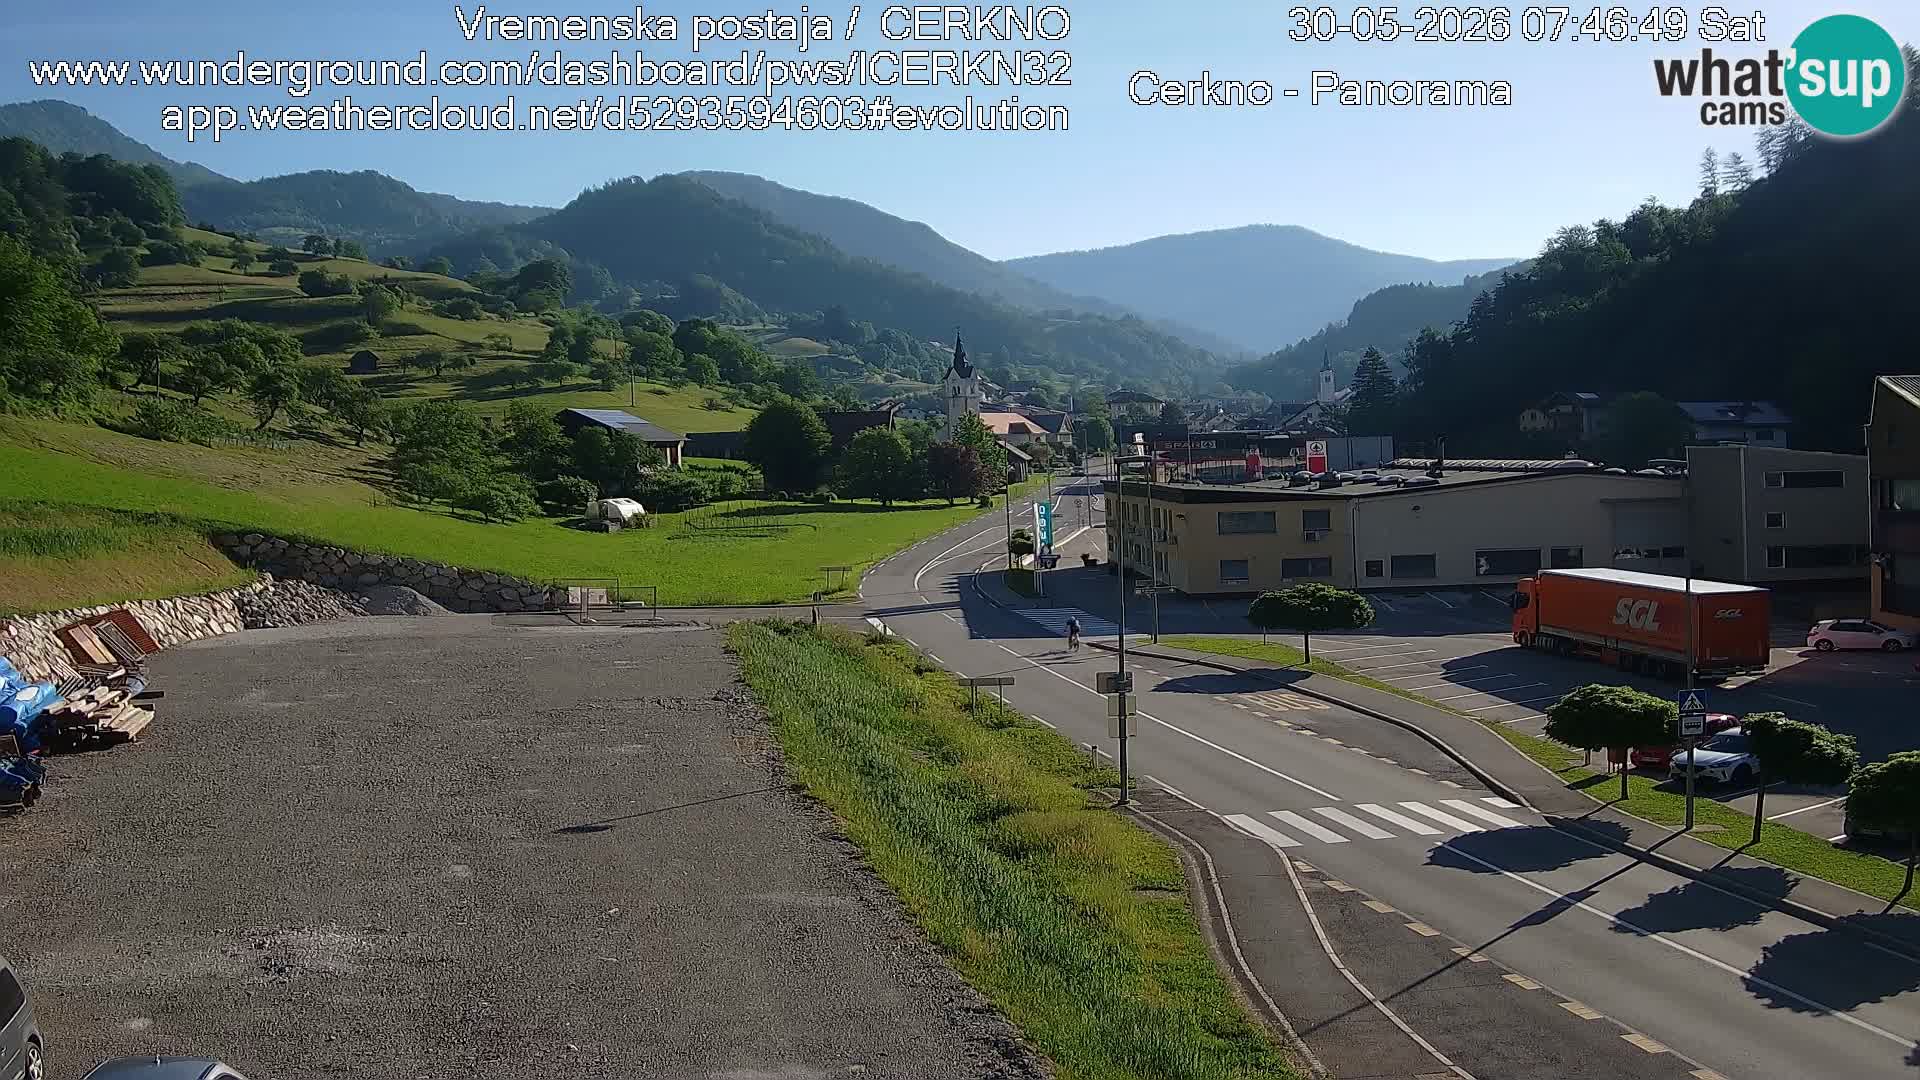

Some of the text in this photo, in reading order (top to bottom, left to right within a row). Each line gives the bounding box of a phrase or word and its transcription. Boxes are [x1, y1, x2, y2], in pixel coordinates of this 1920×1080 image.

[1614, 597, 1660, 631] SGL
[1714, 608, 1744, 619] SGL
[1238, 693, 1331, 712] BUS
